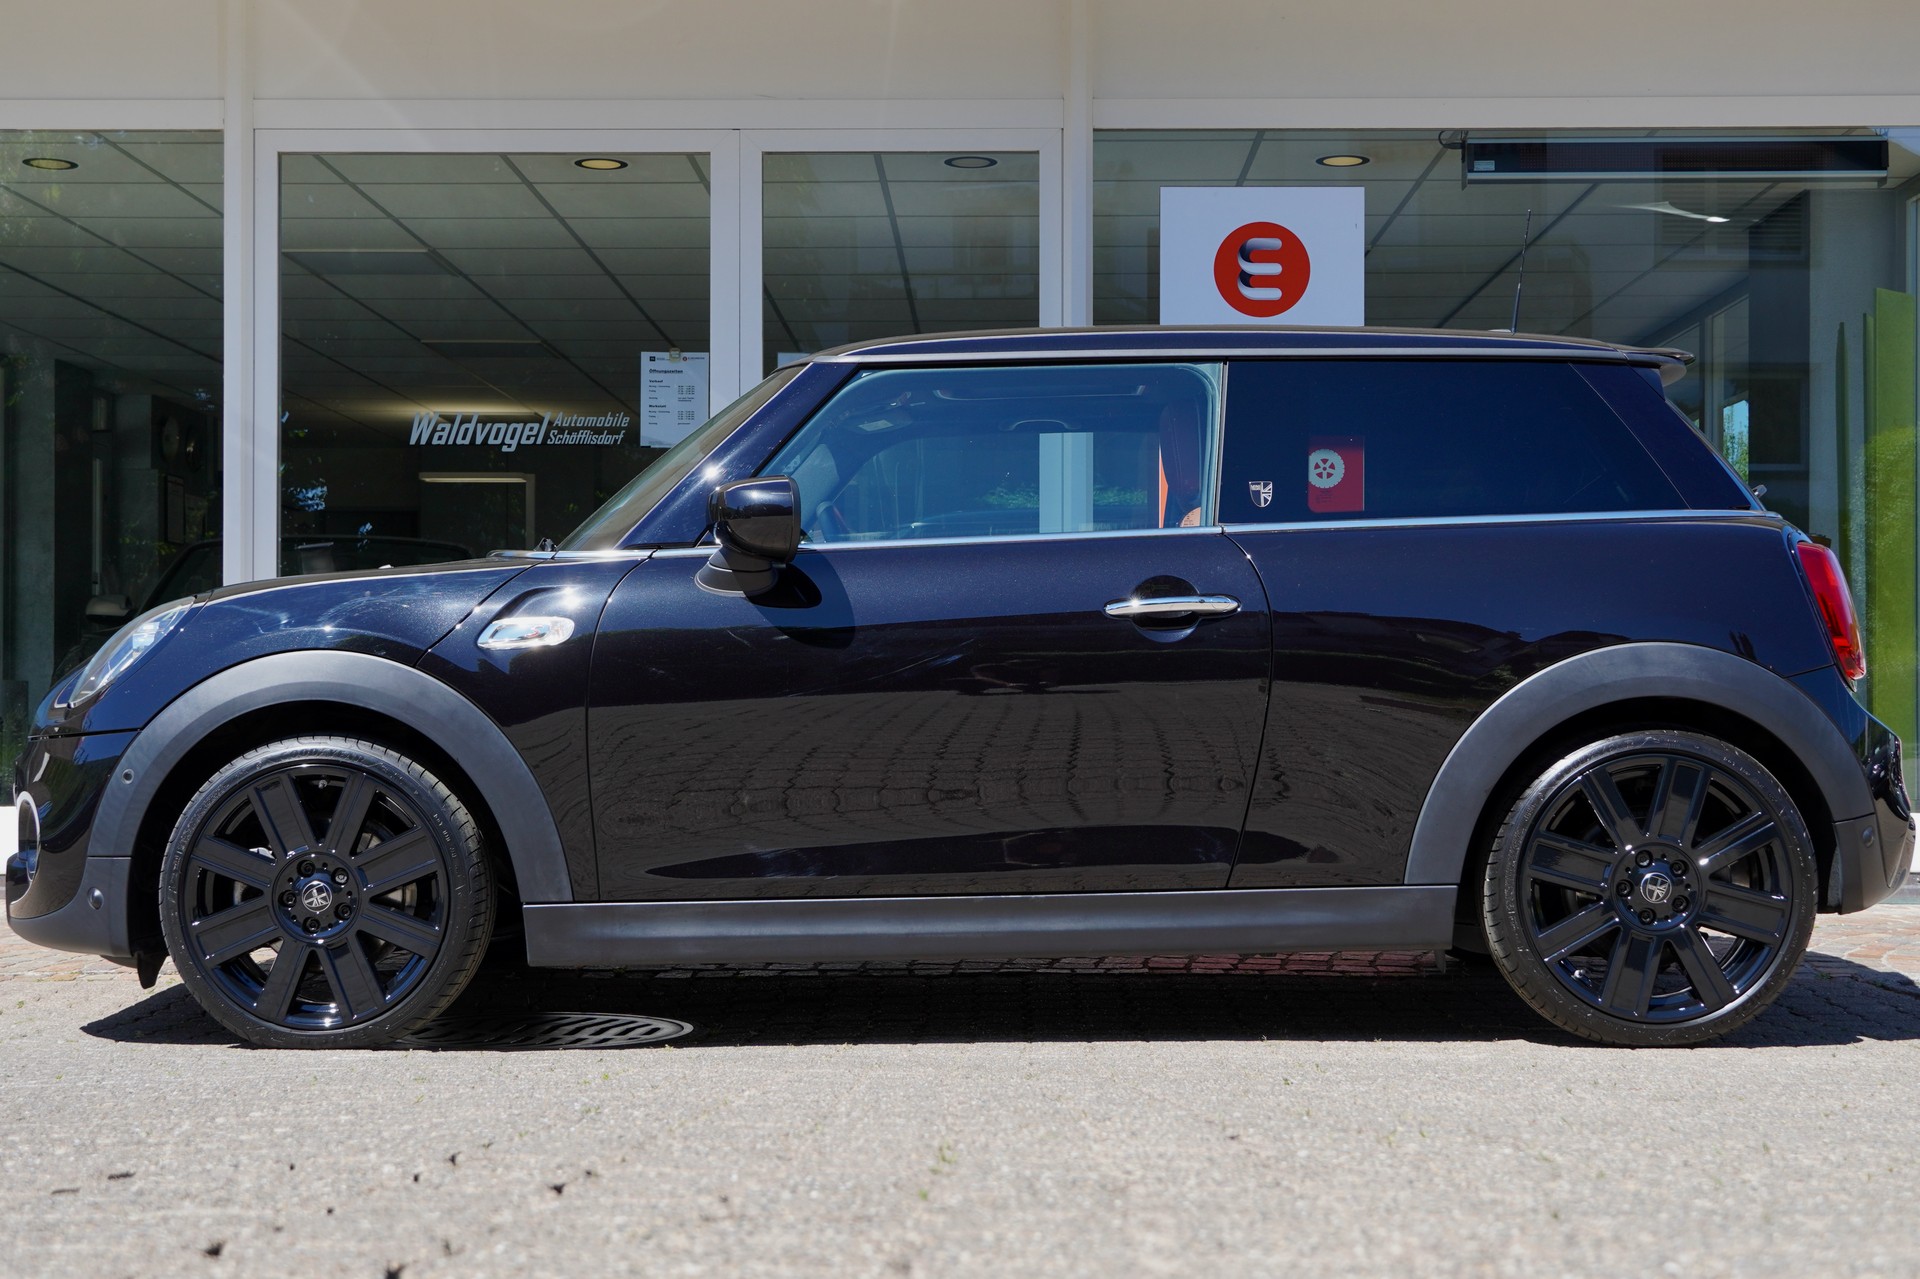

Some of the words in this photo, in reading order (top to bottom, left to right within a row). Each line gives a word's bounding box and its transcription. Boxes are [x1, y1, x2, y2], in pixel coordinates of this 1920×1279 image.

[553, 412, 630, 427] Automobile
[409, 411, 552, 453] Waldvogel
[547, 430, 625, 445] Schöfflisdorf
